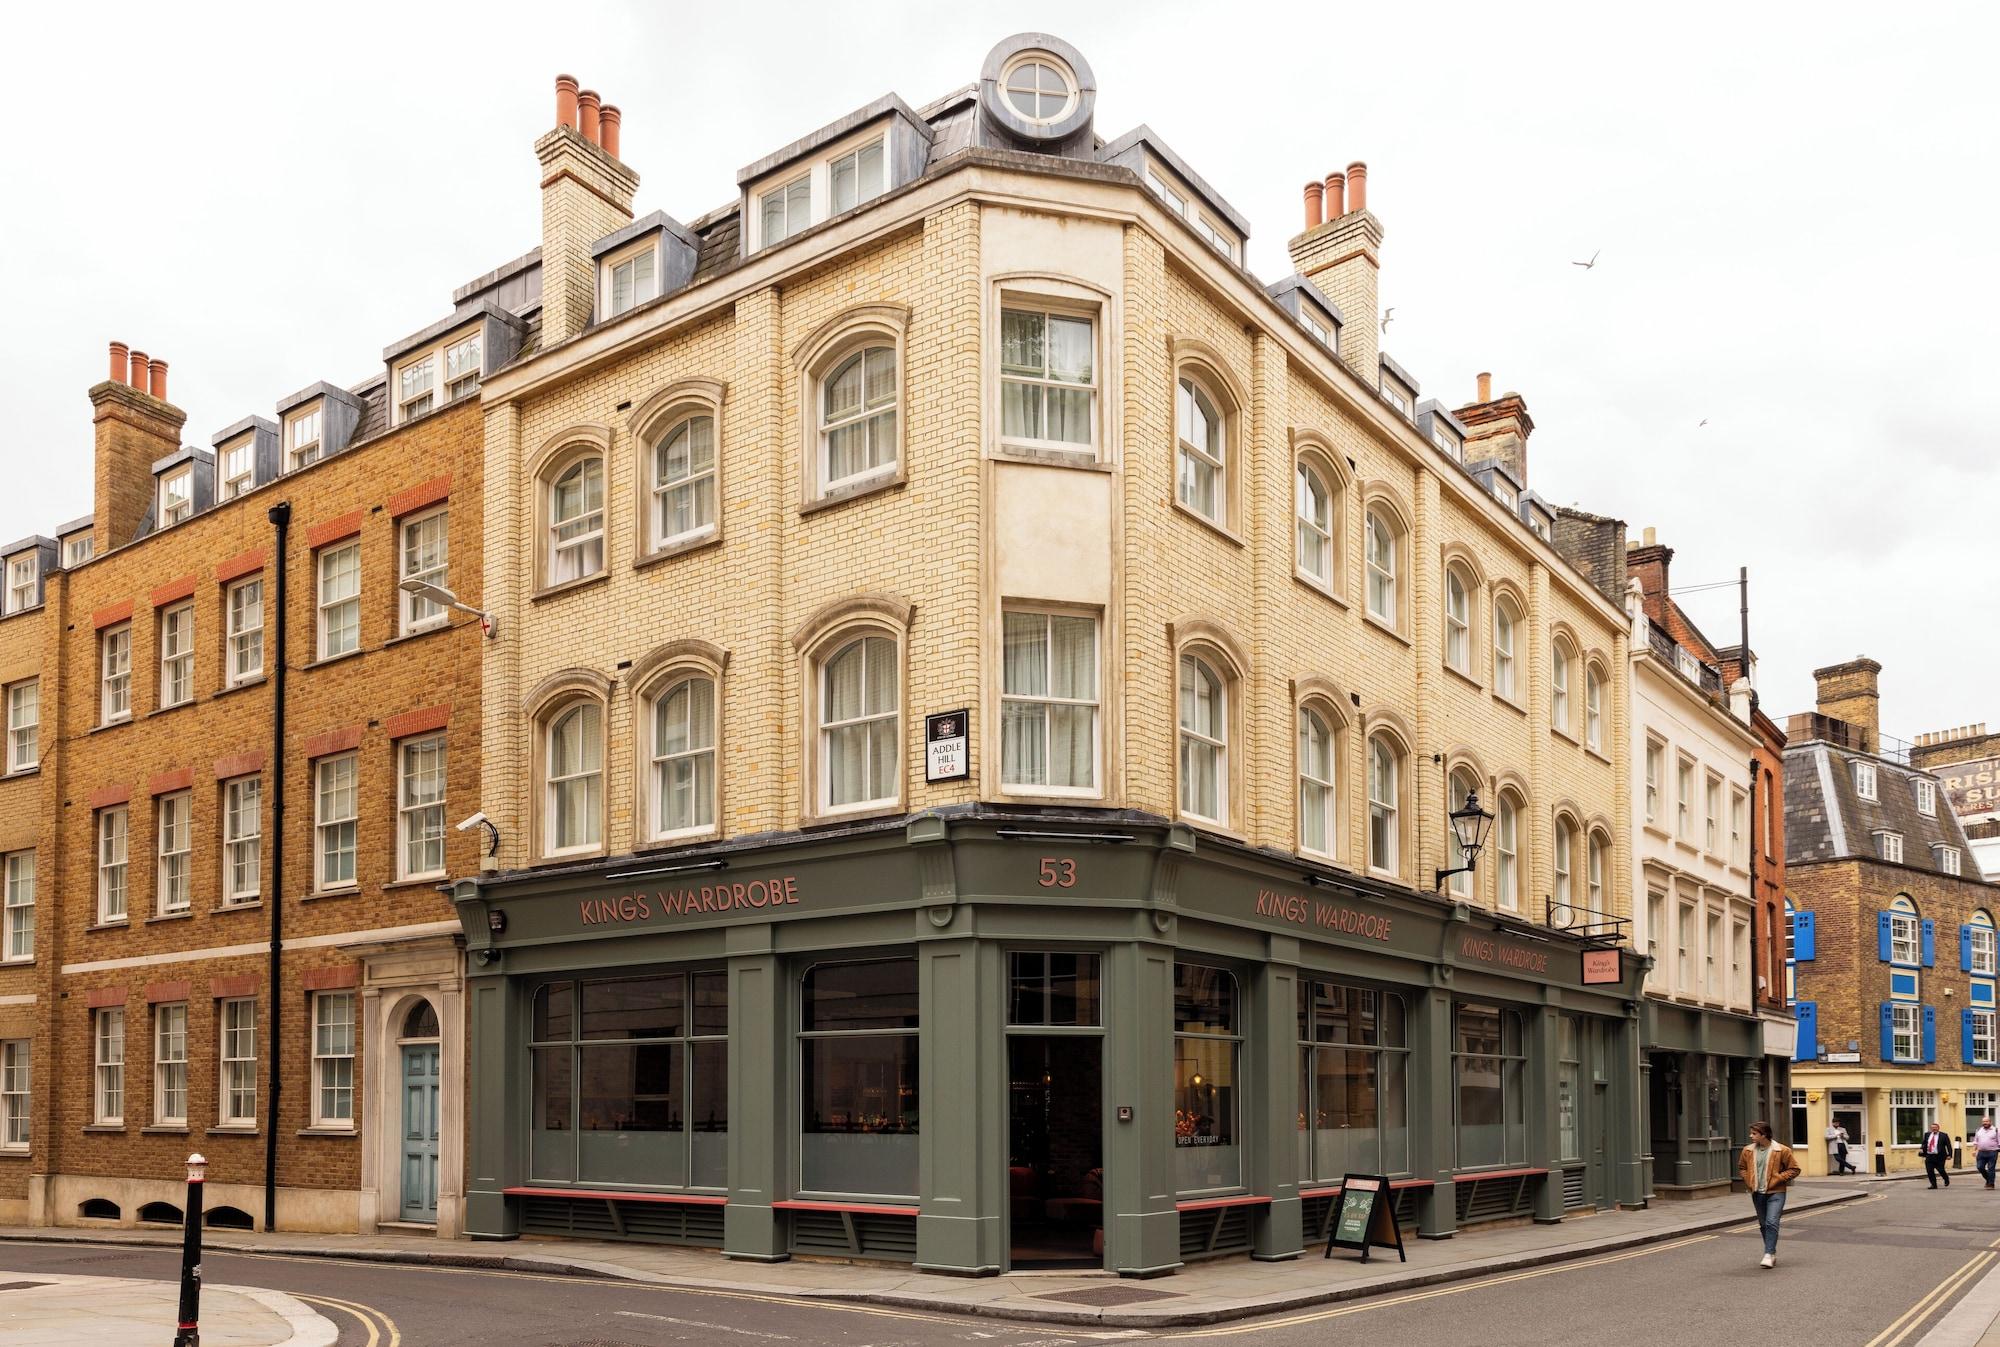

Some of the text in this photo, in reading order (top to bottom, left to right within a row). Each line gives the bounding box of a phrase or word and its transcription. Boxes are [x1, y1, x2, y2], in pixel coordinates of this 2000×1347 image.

[932, 743, 961, 755] ADDLE
[938, 754, 956, 764] HILL
[939, 764, 955, 774] EC4
[1038, 858, 1076, 888] 53
[580, 877, 800, 925] KING'S WARDROBE
[1315, 901, 1392, 941] WARDROBE
[1498, 944, 1548, 973] WARDROBE
[1178, 1136, 1192, 1144] OPEN
